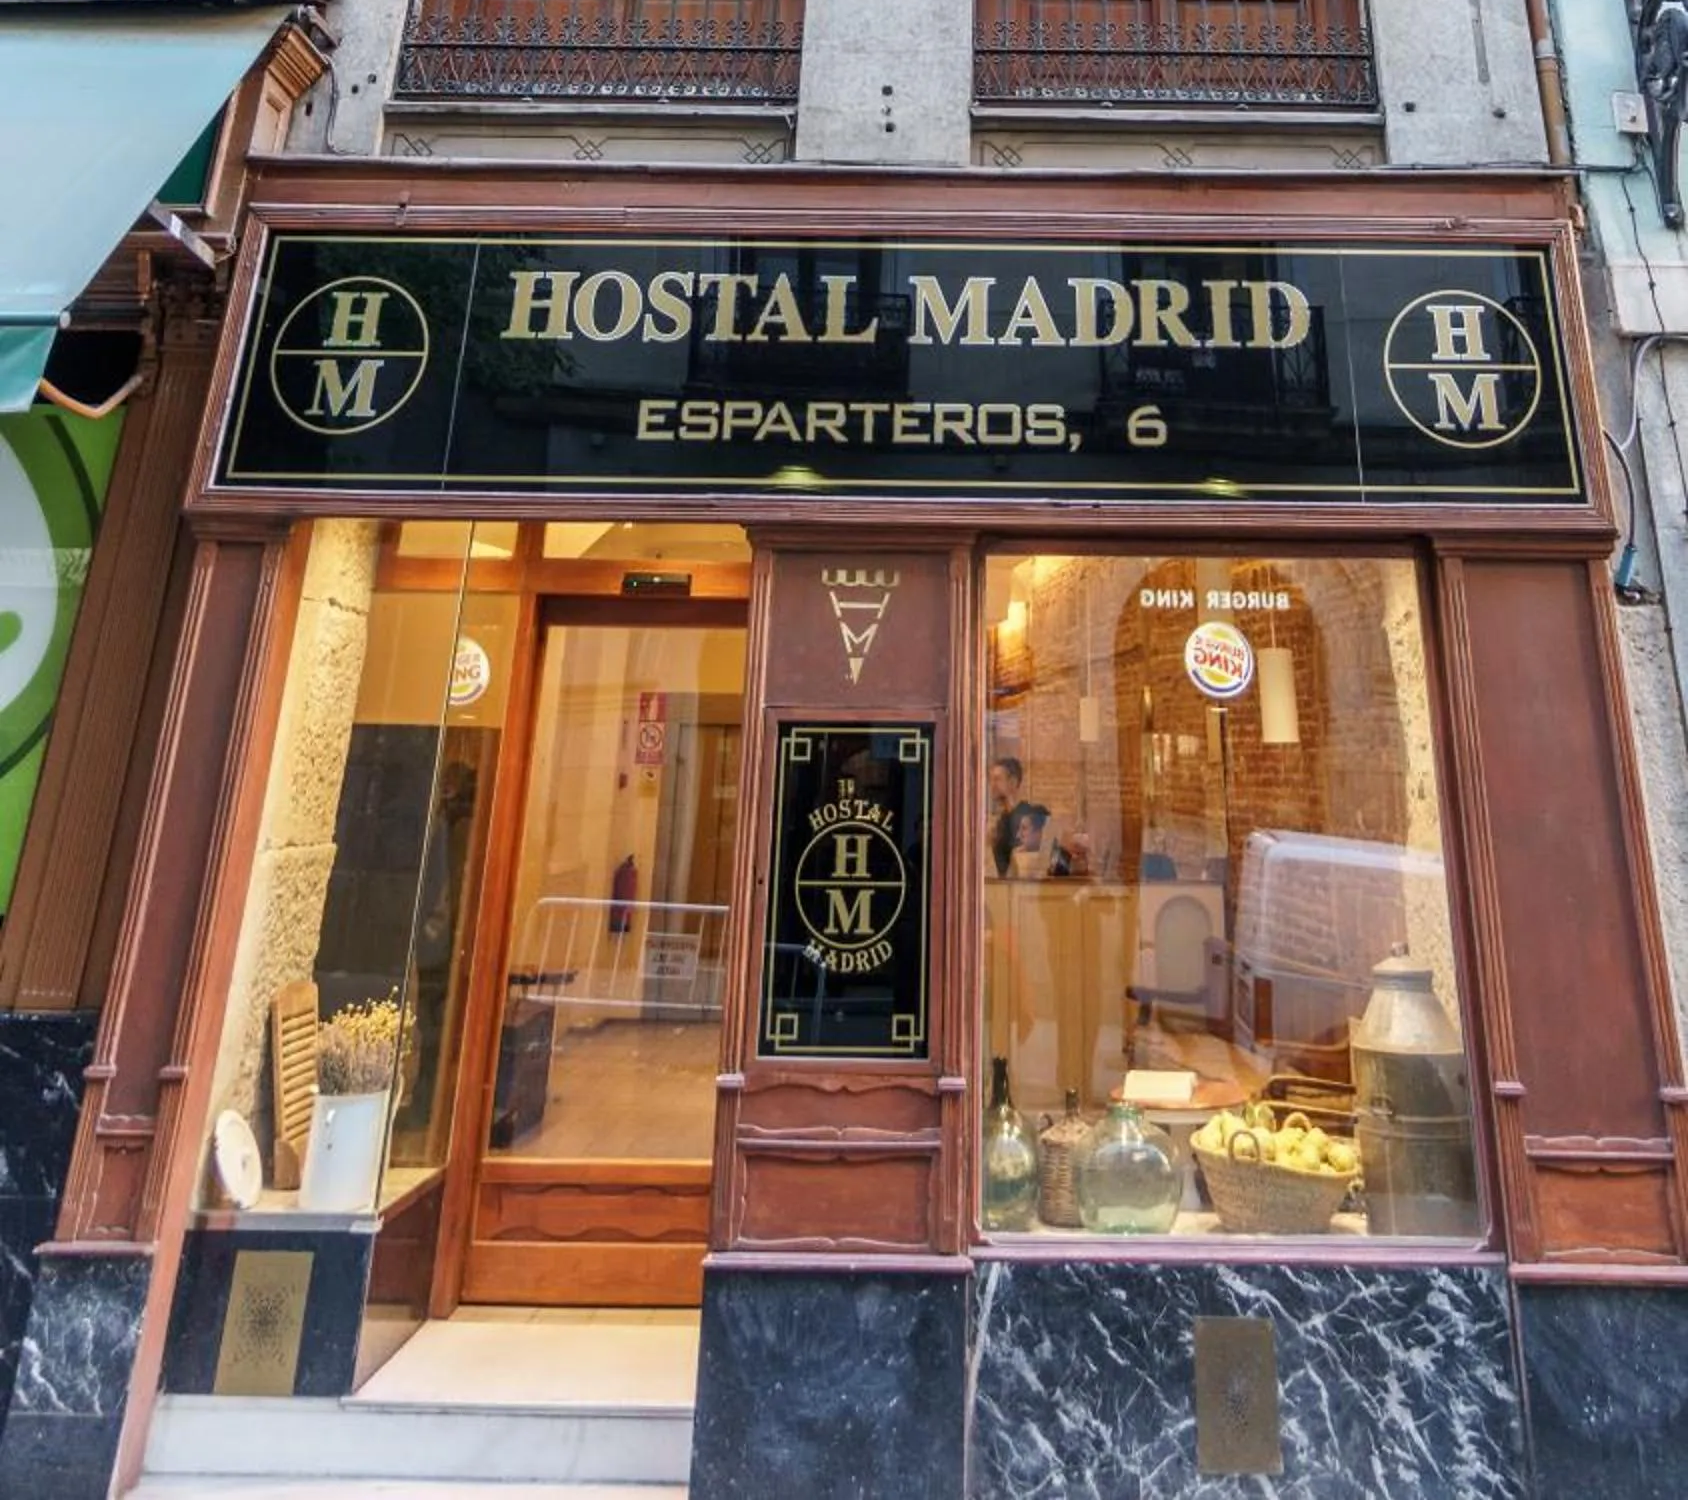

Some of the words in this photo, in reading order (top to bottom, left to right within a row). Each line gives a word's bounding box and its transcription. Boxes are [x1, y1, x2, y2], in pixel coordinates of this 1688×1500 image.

[322, 291, 390, 347] H
[501, 269, 880, 344] HOSTAL
[907, 274, 1311, 349] MADRID
[1425, 304, 1491, 361] H
[303, 359, 385, 417] M
[1427, 372, 1507, 431] M
[635, 399, 1083, 453] ESPARTEROS,
[1127, 404, 1168, 448] 6
[808, 799, 895, 832] HOSTAL
[831, 833, 873, 878] H
[823, 888, 875, 935] M
[802, 938, 893, 974] MADRID
